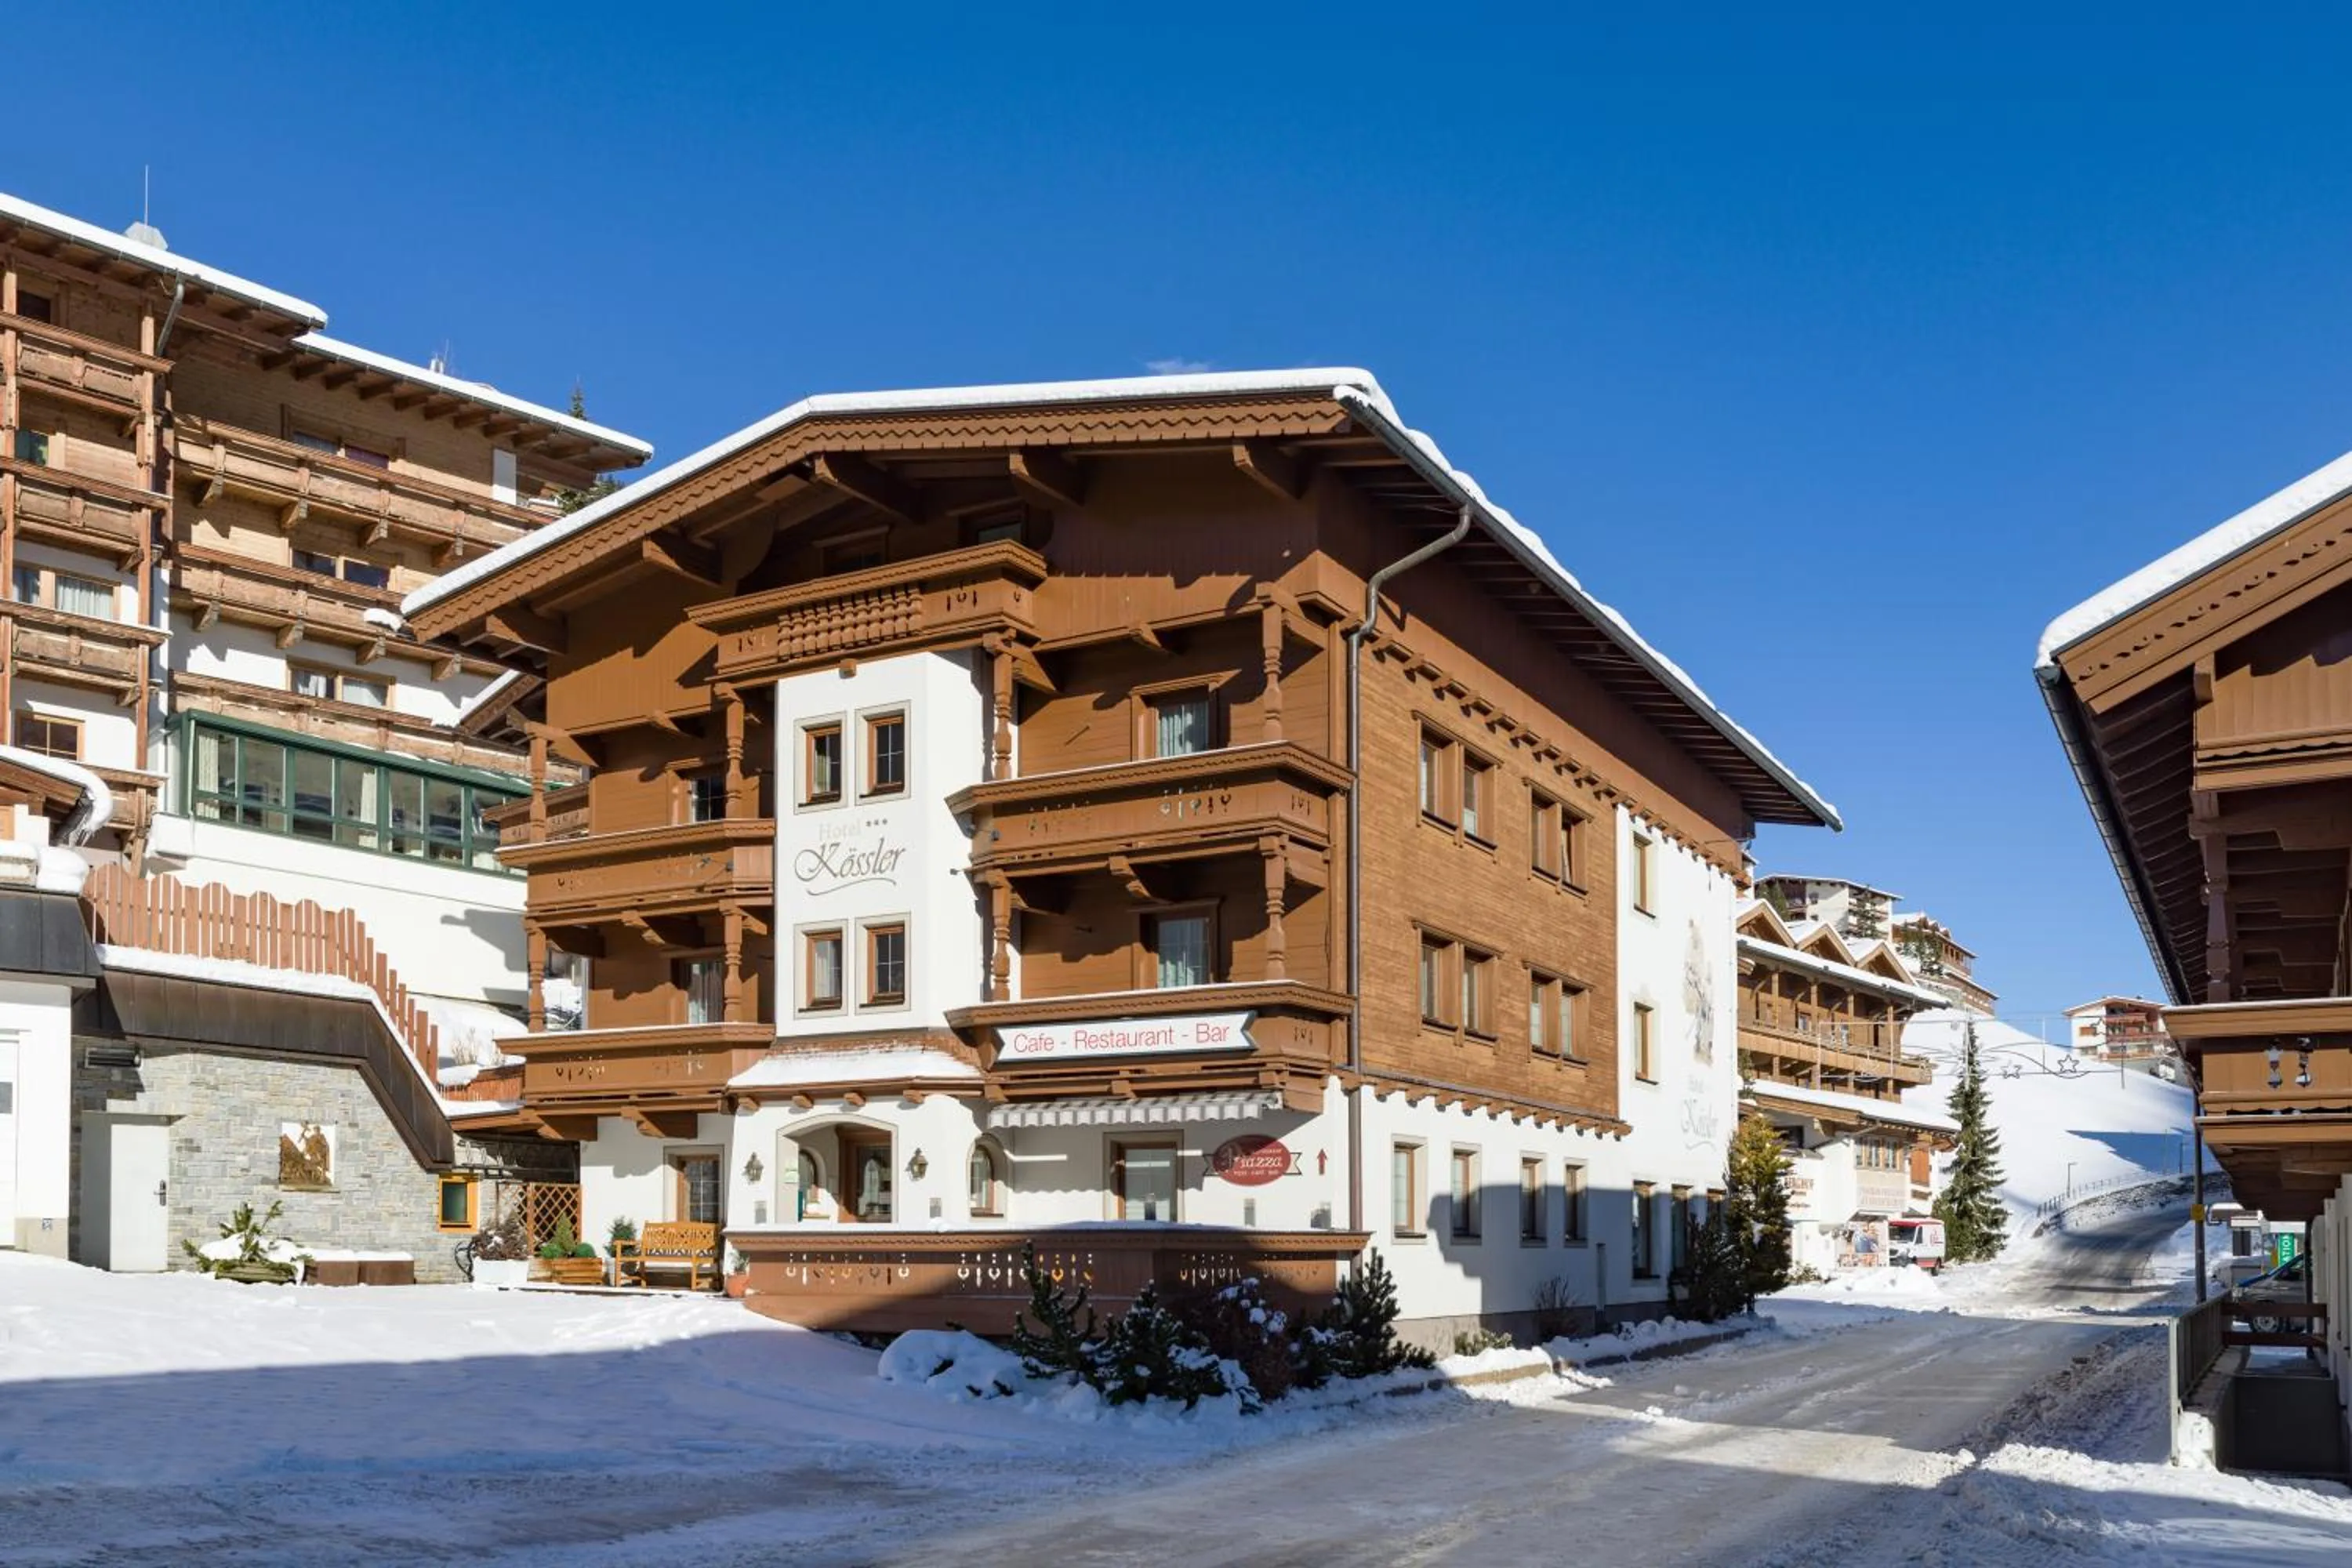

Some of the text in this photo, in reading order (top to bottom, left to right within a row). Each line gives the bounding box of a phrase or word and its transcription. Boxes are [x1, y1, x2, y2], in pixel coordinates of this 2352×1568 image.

[818, 819, 862, 841] Hotel
[794, 837, 907, 882] Kössler
[1013, 1033, 1054, 1053] Cafe
[1074, 1025, 1174, 1050] Restaurant
[1196, 1022, 1230, 1044] Bar
